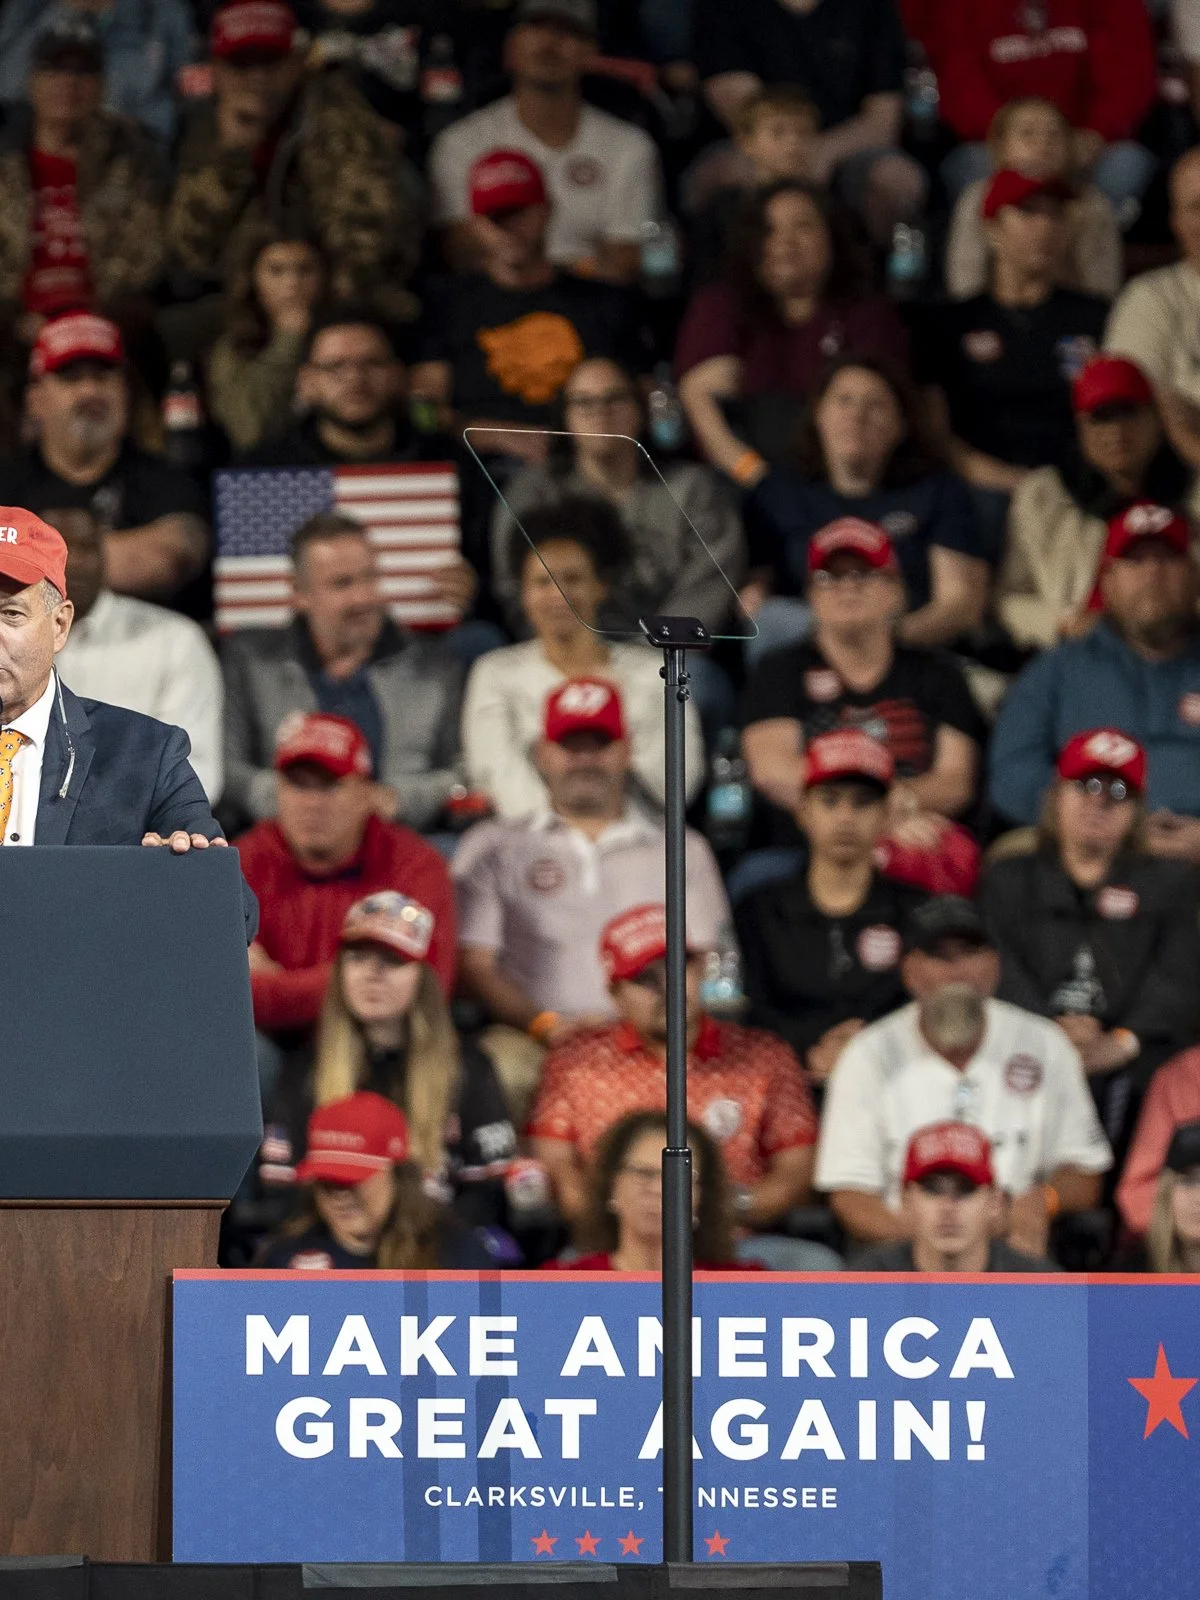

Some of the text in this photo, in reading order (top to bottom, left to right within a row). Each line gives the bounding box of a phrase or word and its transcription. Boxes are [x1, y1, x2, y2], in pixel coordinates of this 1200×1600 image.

[245, 1314, 518, 1377] MAKE
[275, 1397, 598, 1460] GREAT
[424, 1485, 838, 1511] CLARKSVILLE, NNESSEE
